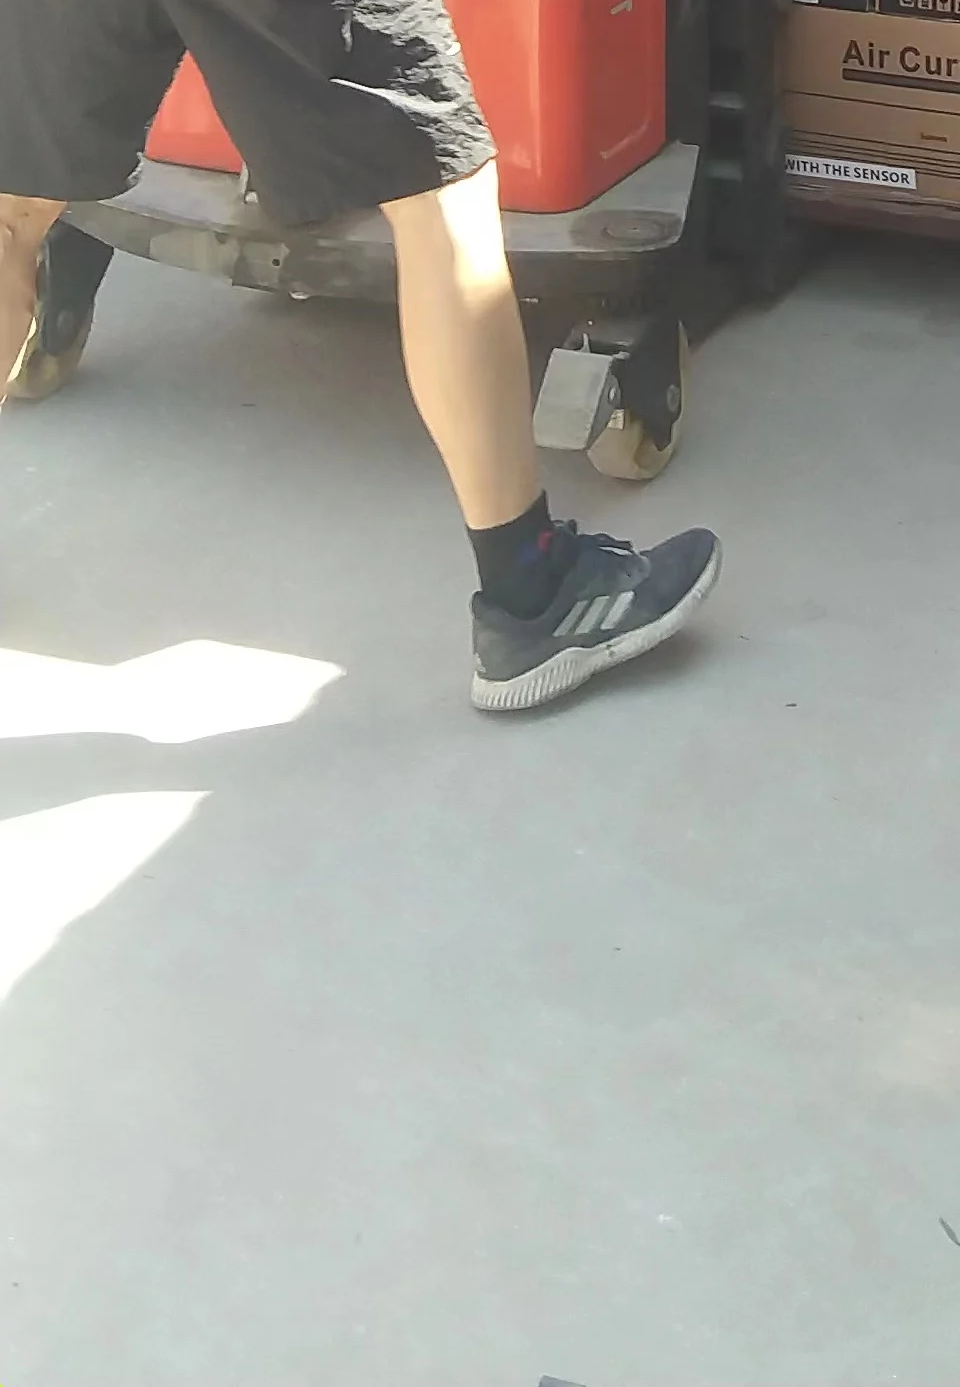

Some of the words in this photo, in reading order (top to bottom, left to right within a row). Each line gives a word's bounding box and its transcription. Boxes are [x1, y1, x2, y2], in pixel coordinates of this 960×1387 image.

[842, 39, 891, 68] Air
[823, 163, 850, 178] THE
[853, 167, 910, 185] SENSOR
